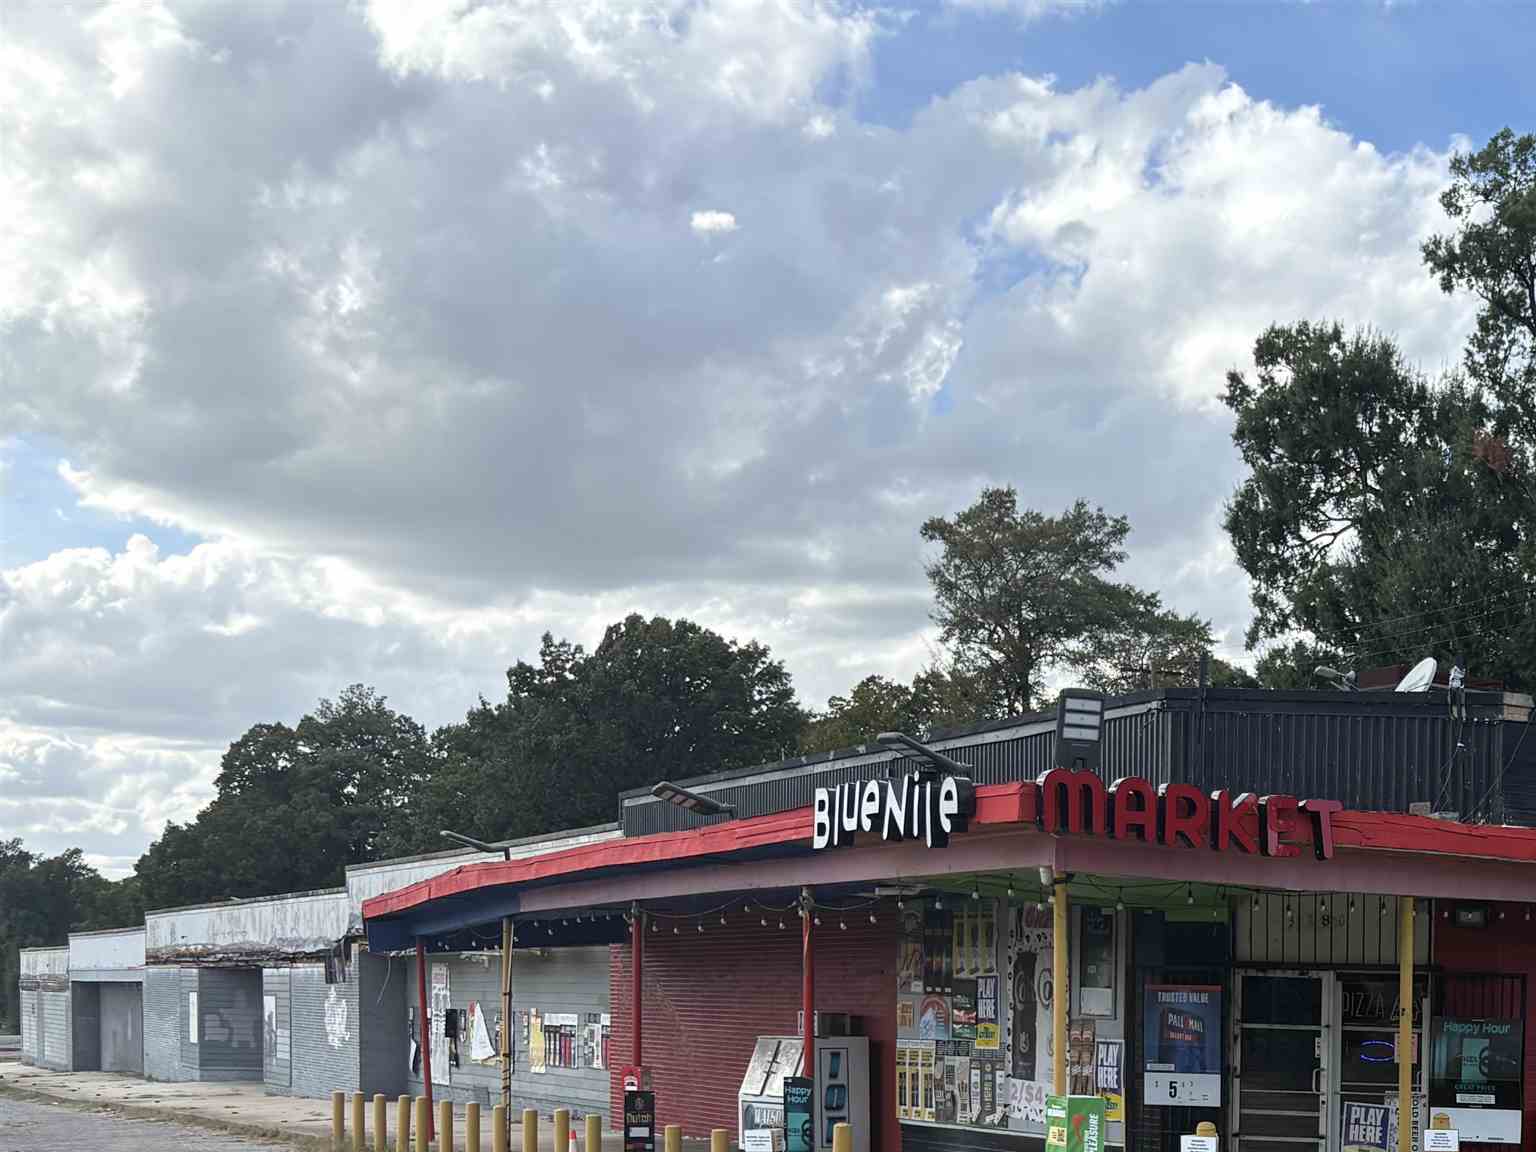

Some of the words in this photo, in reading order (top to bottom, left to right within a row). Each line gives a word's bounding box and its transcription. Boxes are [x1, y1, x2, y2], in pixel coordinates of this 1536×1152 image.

[1040, 768, 1344, 860] MARKET
[977, 978, 995, 998] PLAY
[977, 999, 996, 1019] HERE
[1443, 1021, 1480, 1034] Happy
[1482, 1023, 1511, 1033] Hour
[1098, 1043, 1120, 1066] PLAY
[1097, 1066, 1119, 1089] HERE
[784, 1085, 812, 1096] Happy
[1168, 1080, 1178, 1098] 5
[1350, 1106, 1385, 1126] PLAY
[1349, 1124, 1383, 1144] HERE
